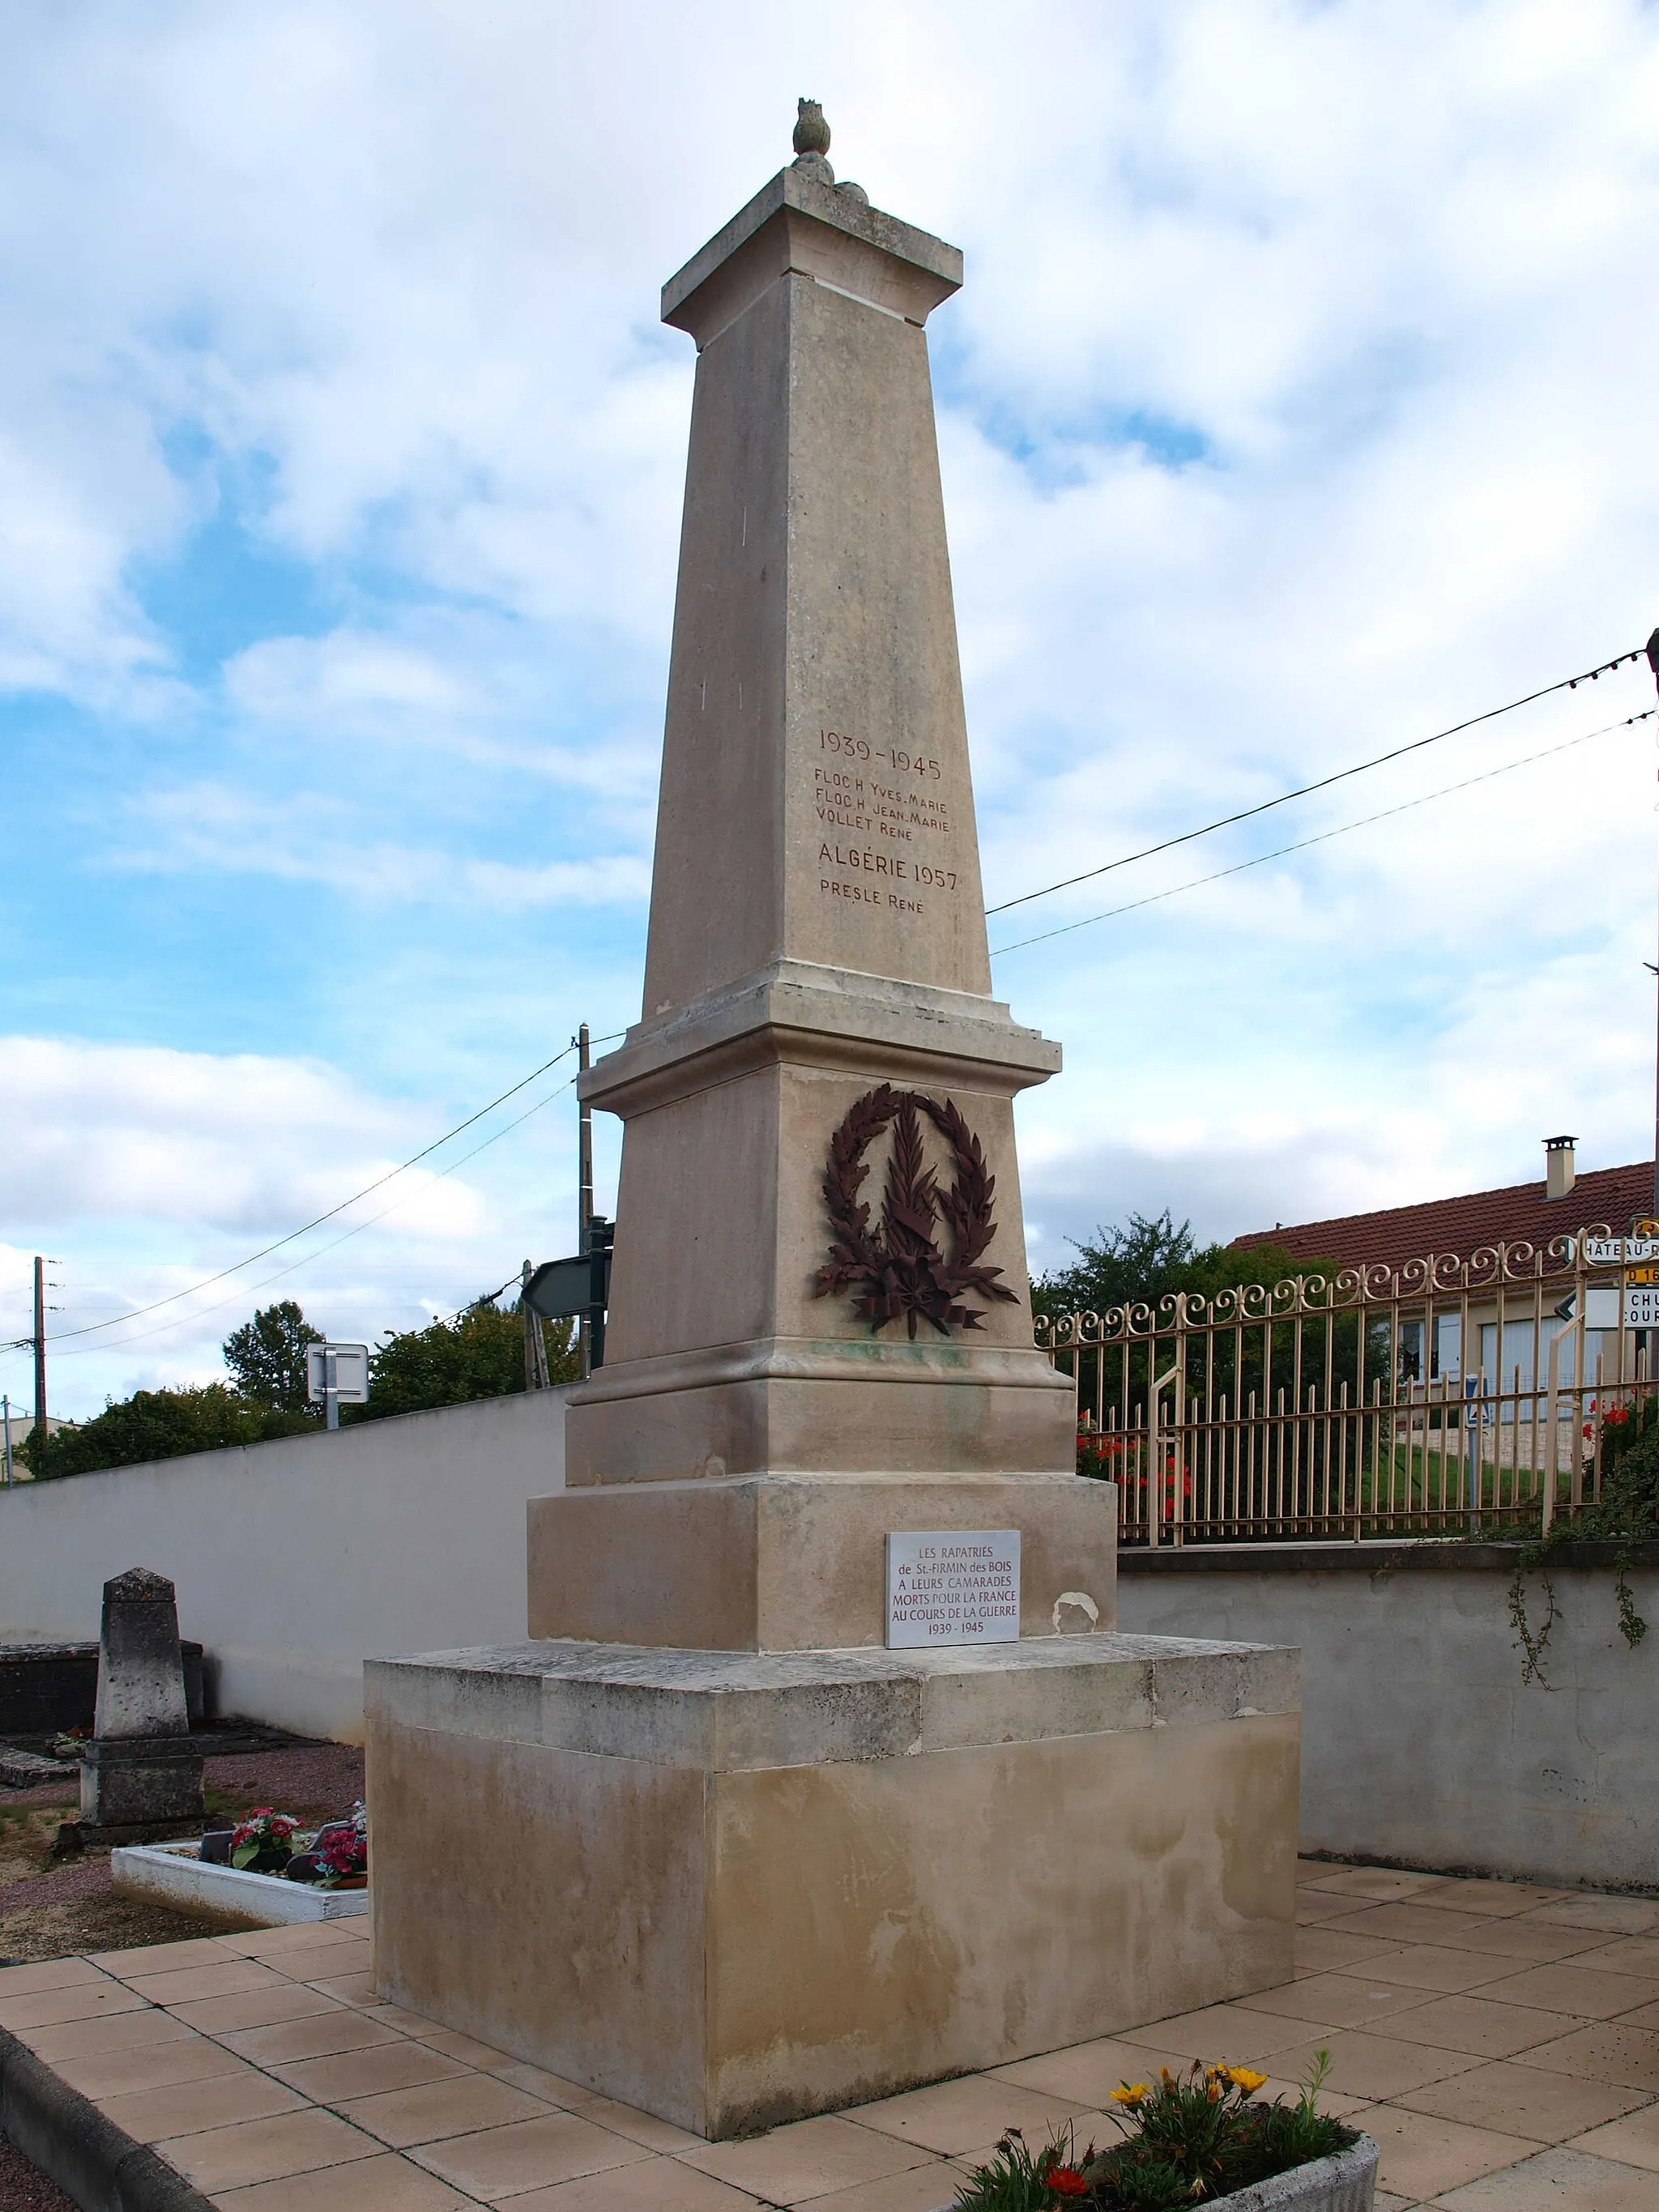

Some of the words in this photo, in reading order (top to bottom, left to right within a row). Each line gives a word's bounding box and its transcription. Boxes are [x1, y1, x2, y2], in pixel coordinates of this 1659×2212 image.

[816, 807, 872, 831] VOLLET
[880, 821, 913, 842] RENÉ
[819, 843, 907, 880] ALGÉRIE
[914, 864, 957, 890] 1957
[820, 879, 881, 905] PRESLE
[889, 895, 924, 914] RENÉ
[1629, 1269, 1636, 1281] D
[919, 1548, 936, 1559] LES
[941, 1545, 994, 1558] RAPATRIÉS
[898, 1563, 911, 1575] de
[970, 1562, 987, 1573] des
[988, 1561, 1012, 1572] BOIS
[898, 1579, 906, 1590] A
[911, 1578, 943, 1590] LEURS
[948, 1575, 1012, 1589] CAMARADES
[893, 1594, 930, 1606] MORTS
[932, 1592, 961, 1605] POUR
[963, 1592, 977, 1603] LA
[979, 1590, 1017, 1603] FRANCE
[892, 1610, 907, 1622] AU
[910, 1609, 945, 1621] COURS
[948, 1608, 961, 1619] DE
[963, 1607, 977, 1618] LA
[979, 1605, 1017, 1617] GUERRE
[928, 1623, 952, 1635] 1939
[962, 1622, 984, 1634] 1945
